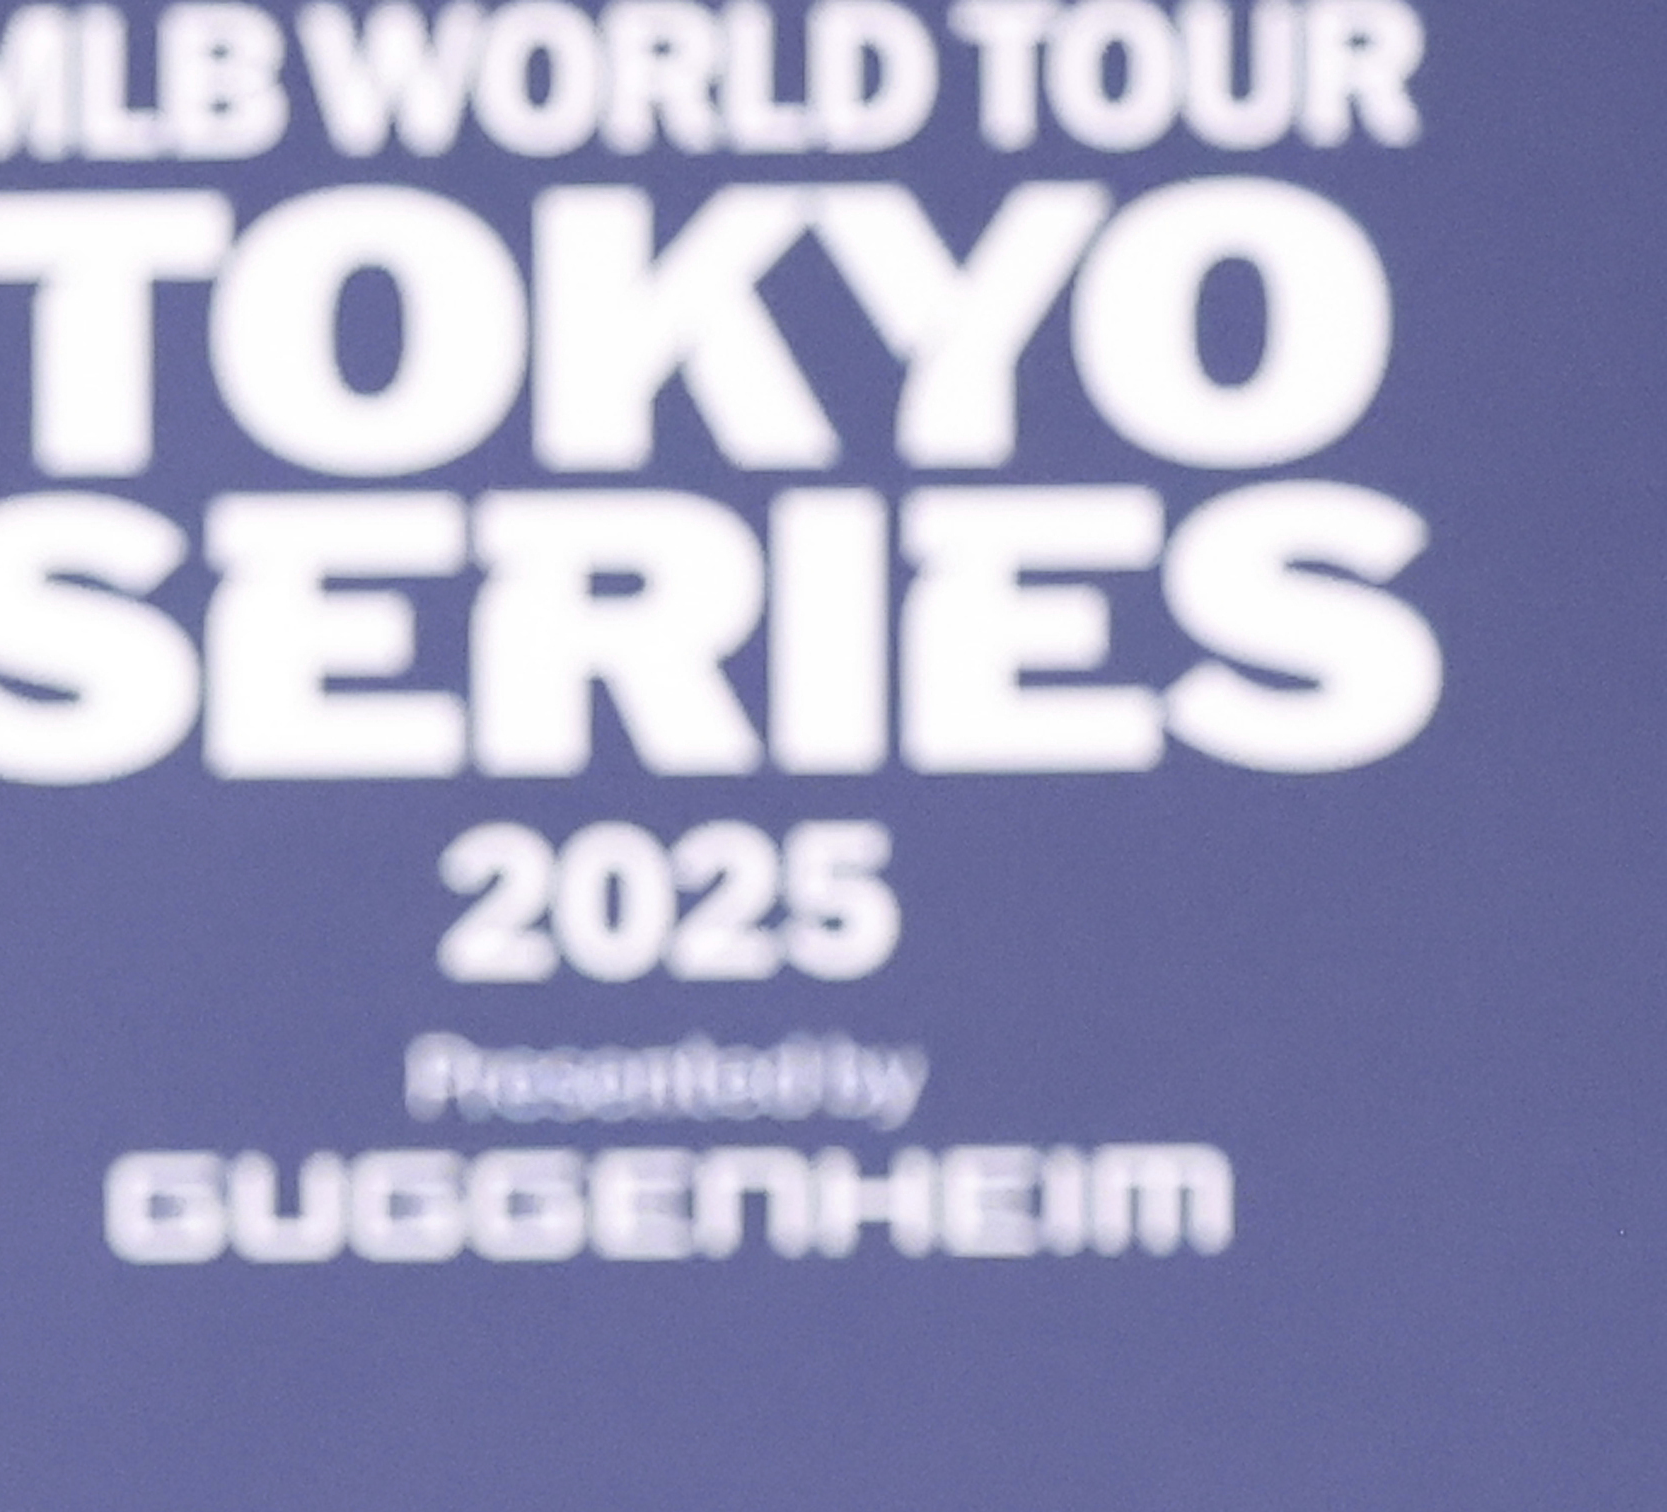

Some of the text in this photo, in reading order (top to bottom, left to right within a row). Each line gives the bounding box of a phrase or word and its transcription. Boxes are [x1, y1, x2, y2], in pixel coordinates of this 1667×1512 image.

[298, 0, 938, 157] WORLD
[949, 0, 1425, 151] TOUR
[437, 820, 901, 982] 2025
[104, 1143, 1234, 1264] GUGGENHEIM
